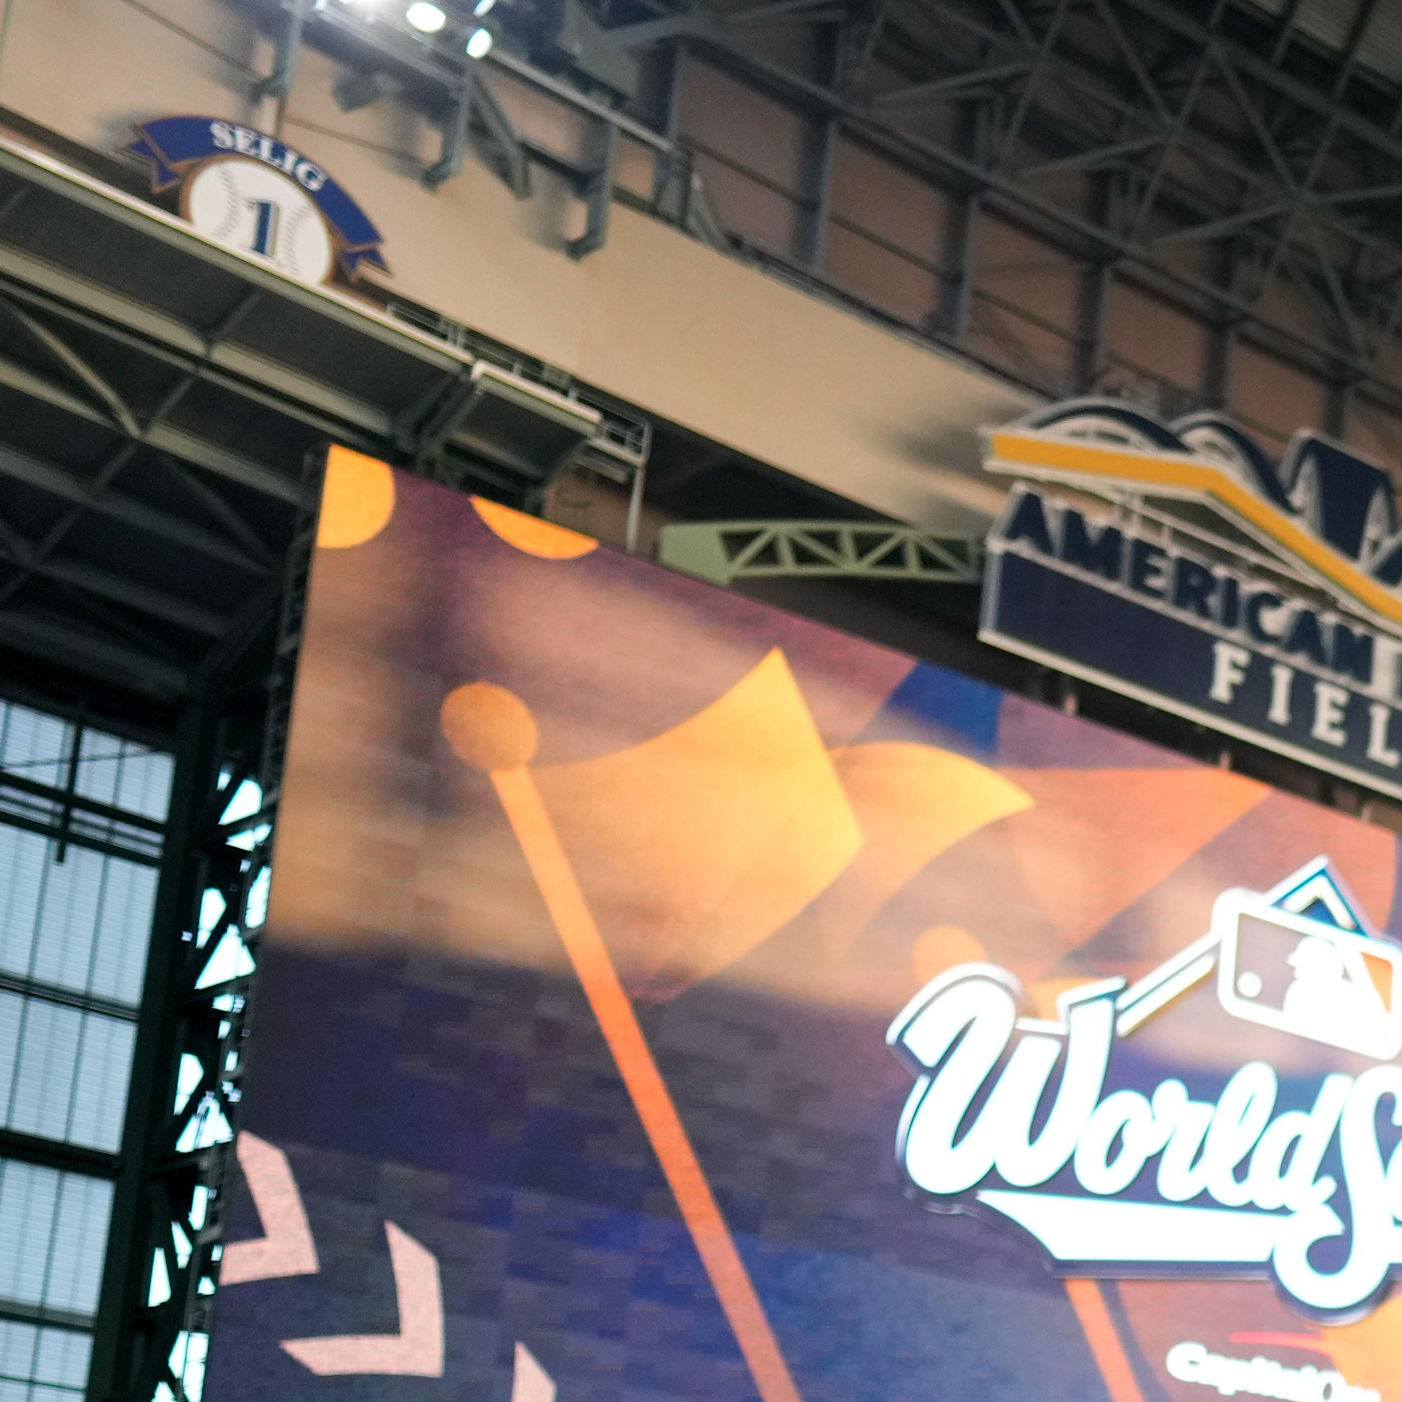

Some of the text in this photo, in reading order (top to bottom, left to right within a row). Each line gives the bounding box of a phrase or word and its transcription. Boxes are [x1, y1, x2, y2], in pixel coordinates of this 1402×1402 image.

[209, 119, 328, 193] SELIG
[247, 200, 279, 259] 1
[1004, 486, 1374, 690] AMERICAN
[887, 962, 1356, 1213] World
